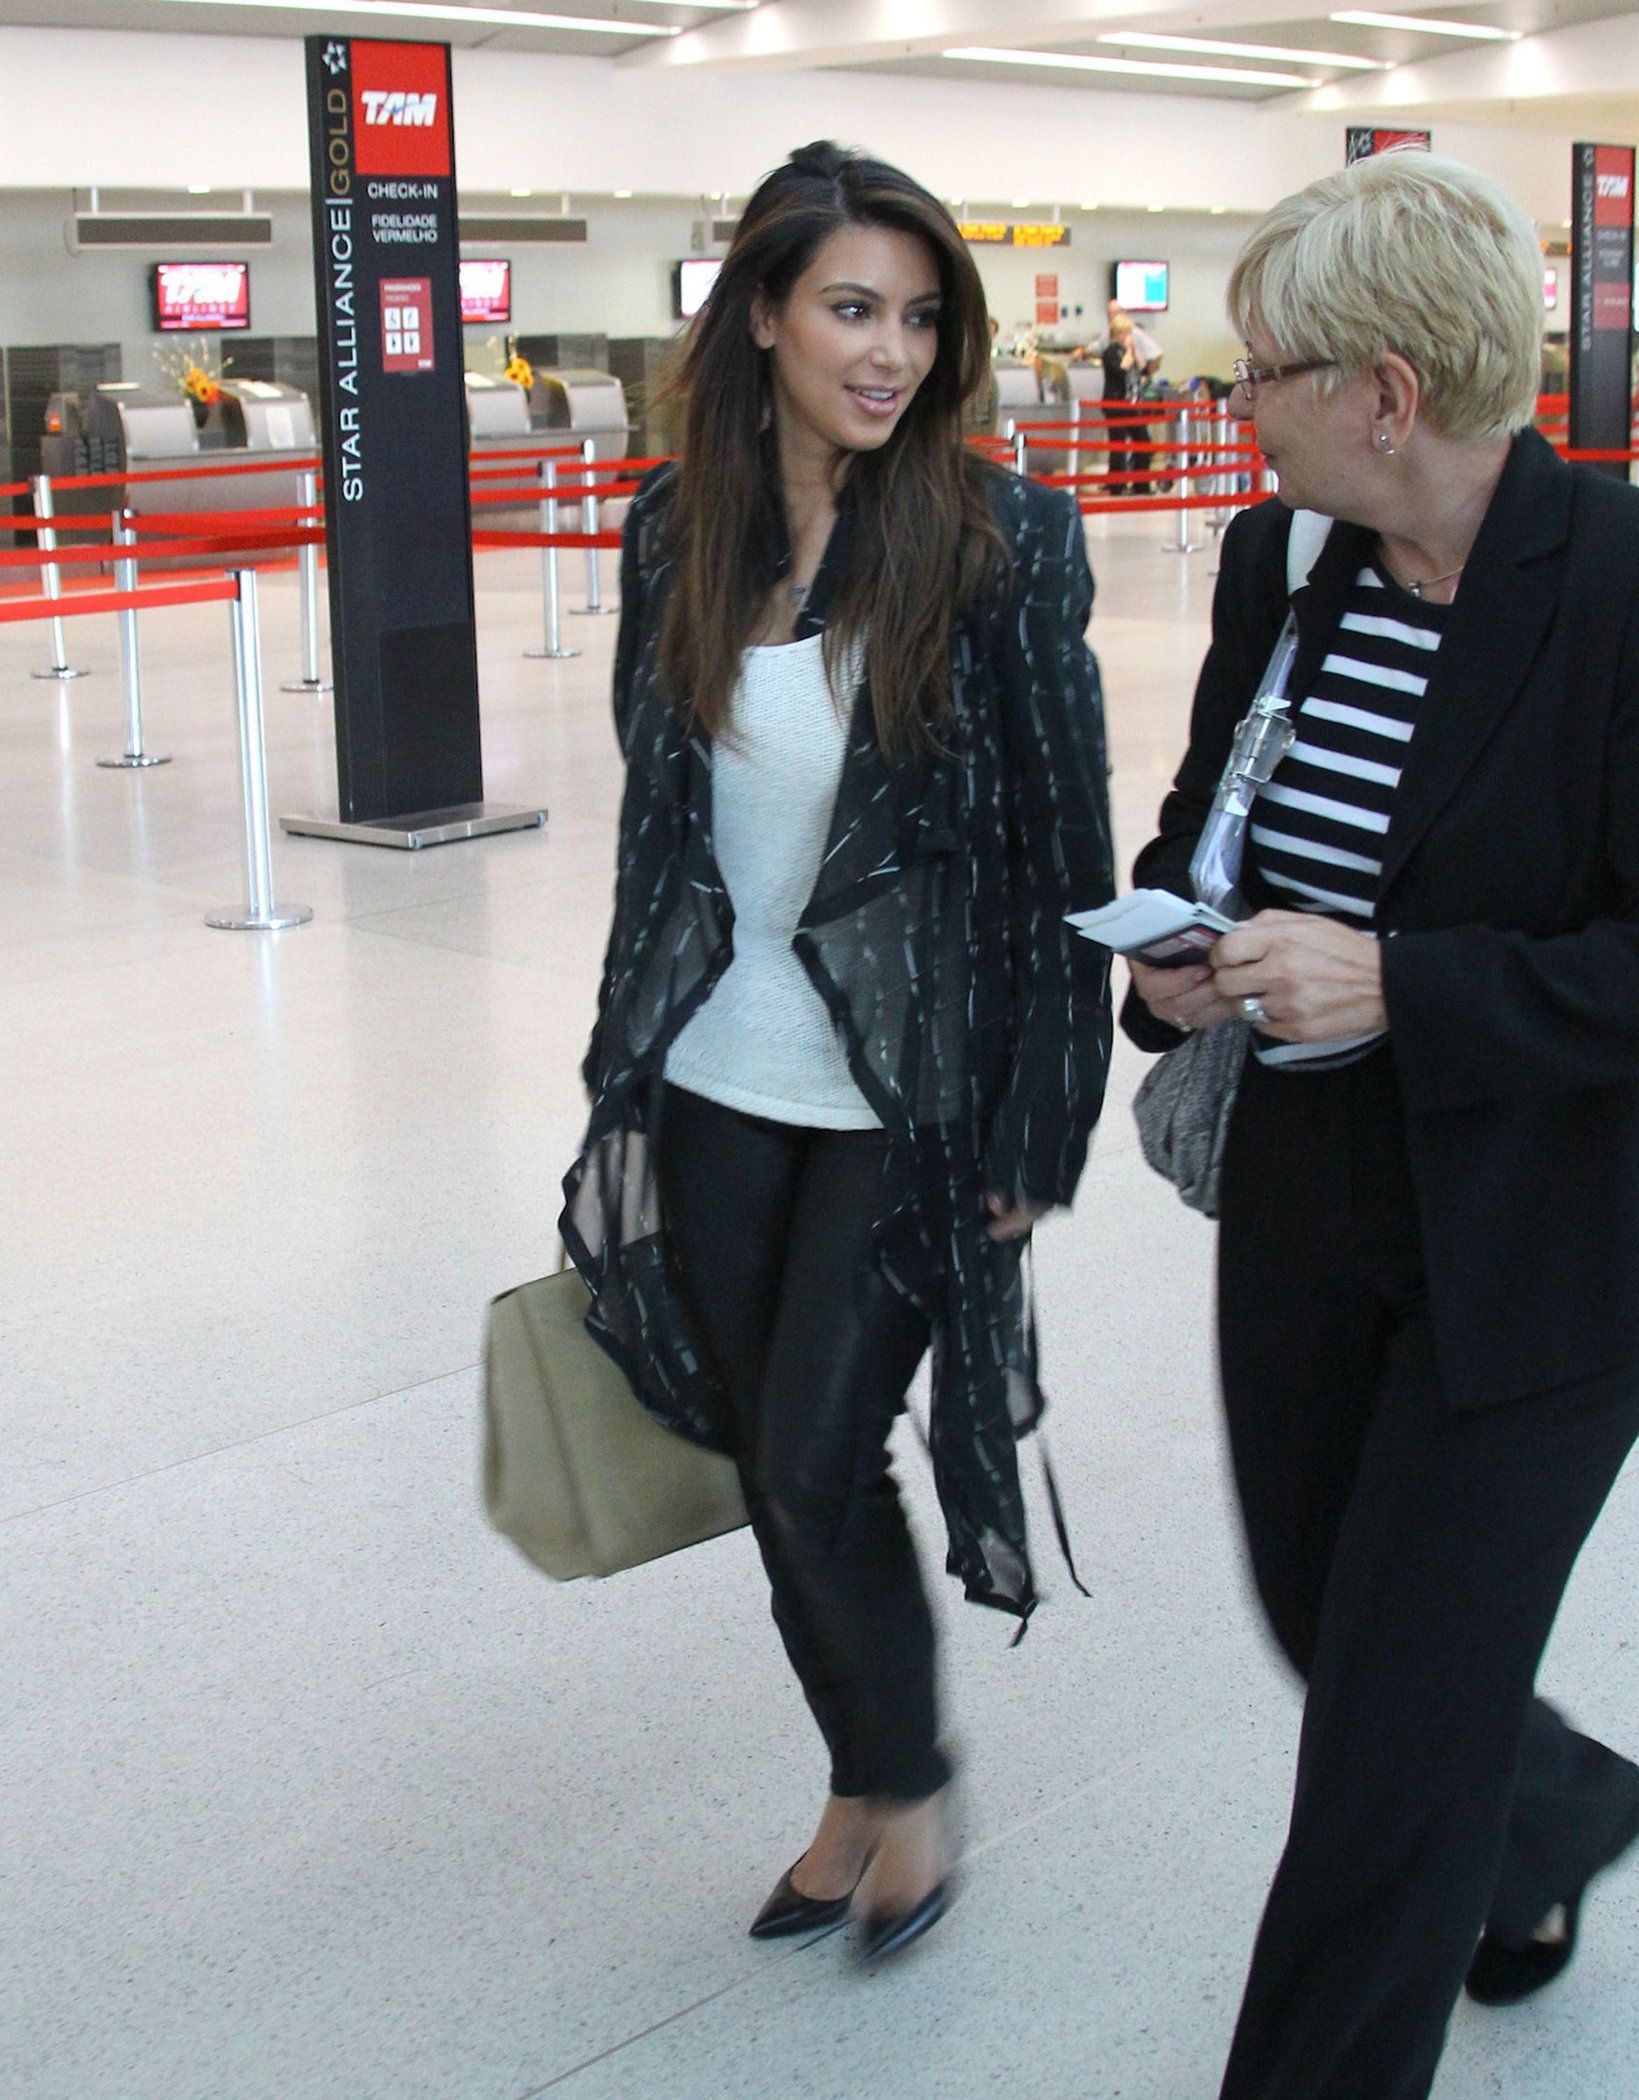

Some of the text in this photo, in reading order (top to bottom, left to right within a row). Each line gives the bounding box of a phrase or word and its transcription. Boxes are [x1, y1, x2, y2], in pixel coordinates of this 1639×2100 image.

[361, 90, 437, 127] TAM
[367, 181, 438, 199] CHECK-IN
[371, 213, 437, 229] FIDELIDADE
[372, 229, 438, 243] VERMELHO
[327, 88, 363, 501] STAR ALLIANCE GOLD
